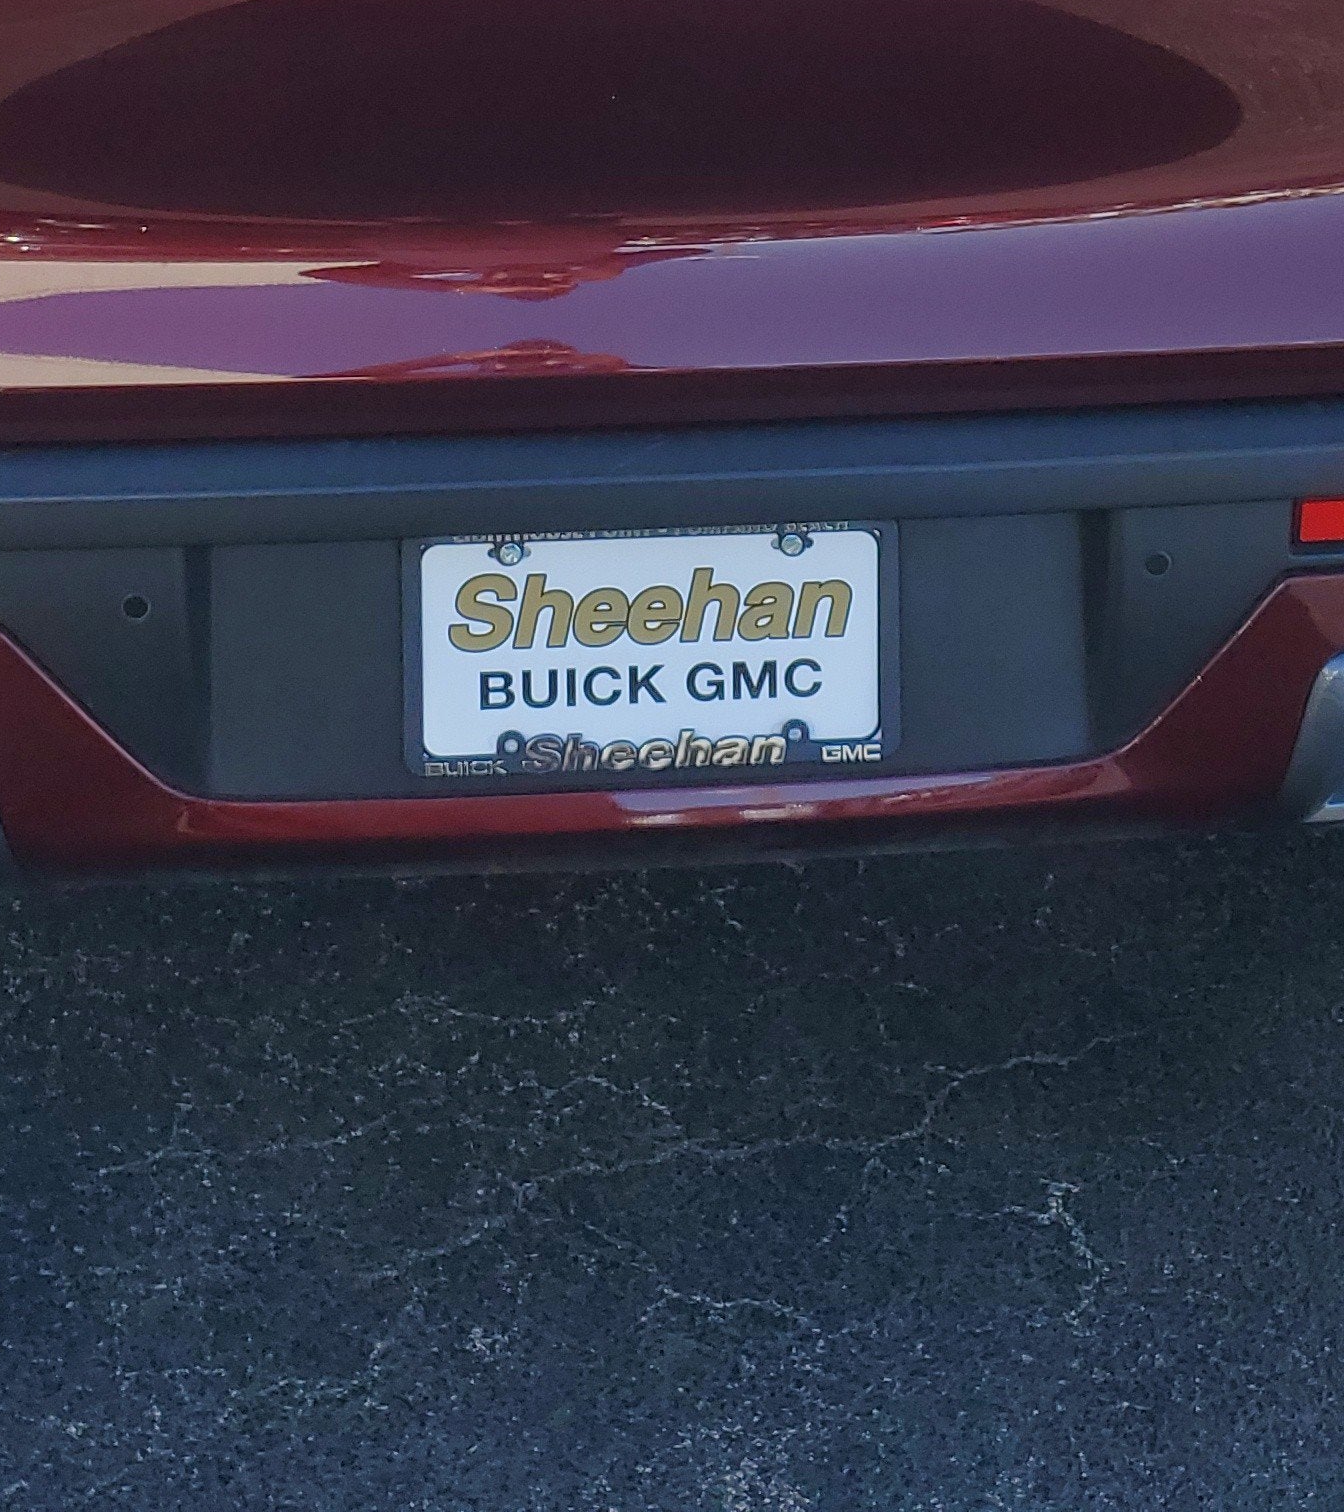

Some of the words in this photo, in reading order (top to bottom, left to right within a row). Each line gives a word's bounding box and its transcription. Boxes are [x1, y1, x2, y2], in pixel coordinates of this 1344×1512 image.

[448, 567, 853, 653] Sheehan
[479, 664, 667, 710] BUICK
[686, 658, 823, 701] GMC
[424, 758, 507, 778] BUICK
[522, 728, 787, 773] Sheehan
[821, 743, 882, 763] GMC
